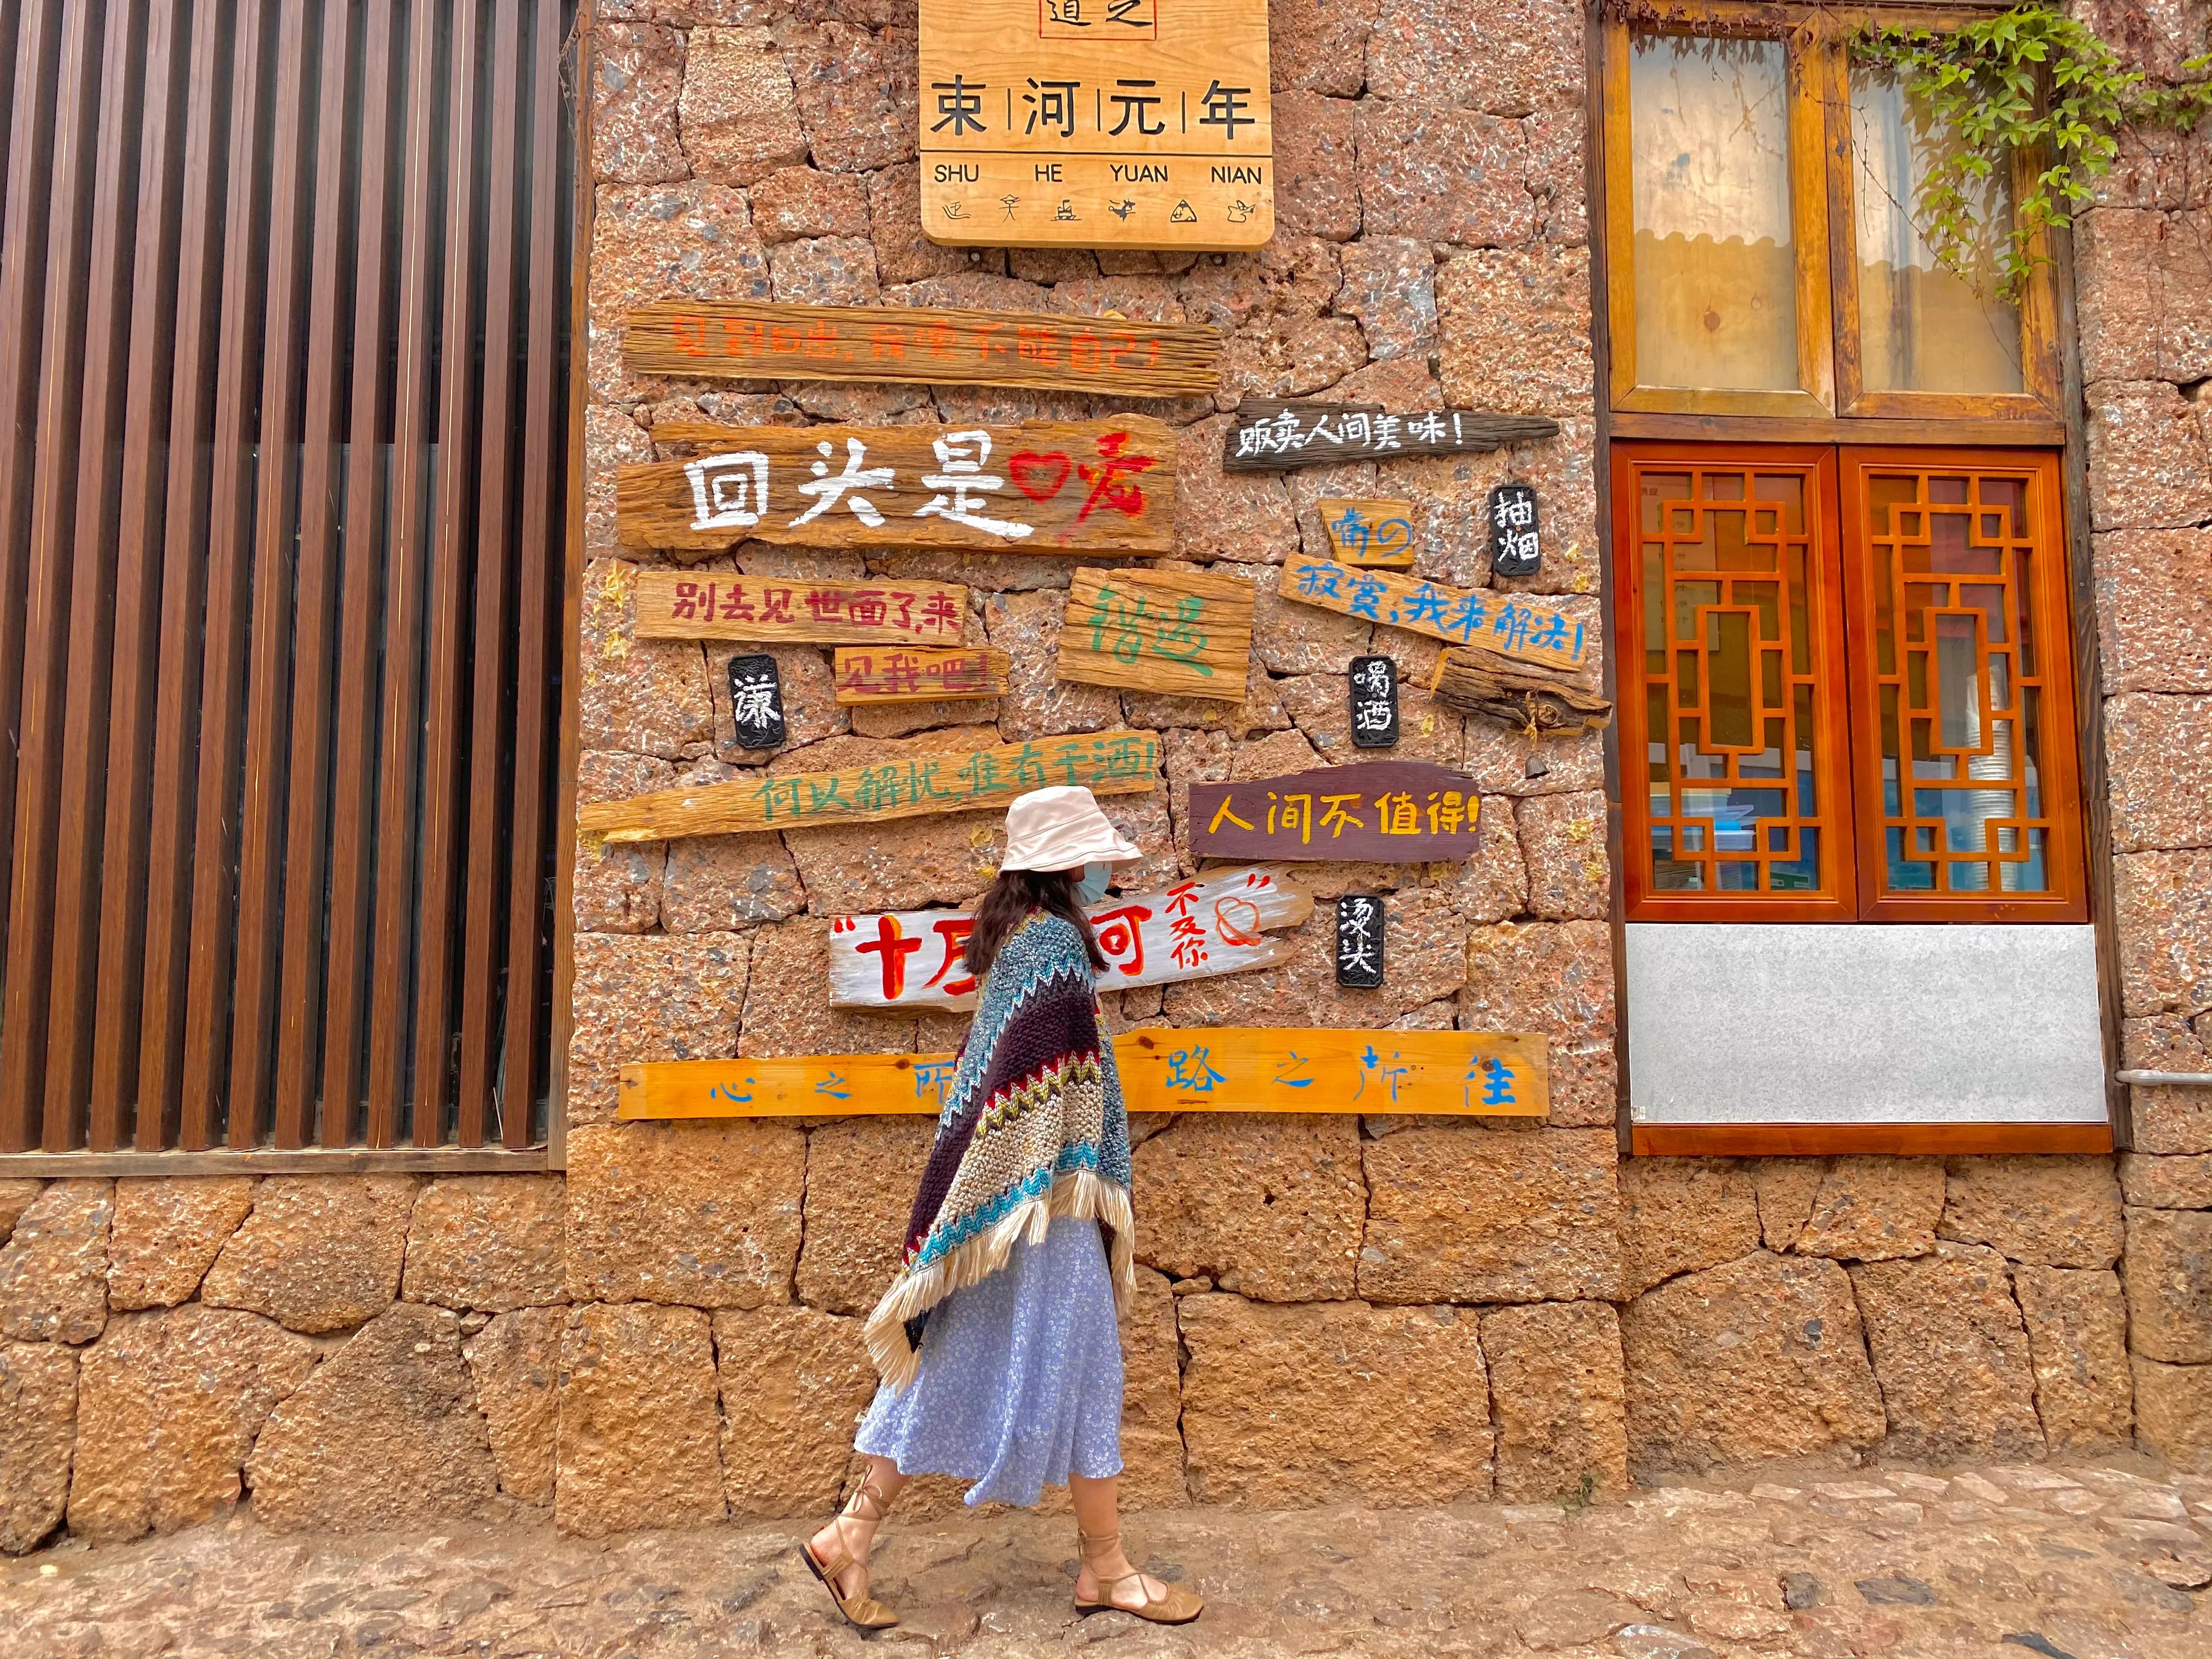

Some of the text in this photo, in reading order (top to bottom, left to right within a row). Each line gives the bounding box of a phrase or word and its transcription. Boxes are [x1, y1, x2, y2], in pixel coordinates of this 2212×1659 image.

[934, 164, 1262, 184] SHU HE YUAN NIAN
[1493, 492, 1538, 562] 抽烟
[1353, 661, 1392, 731] 喝酒
